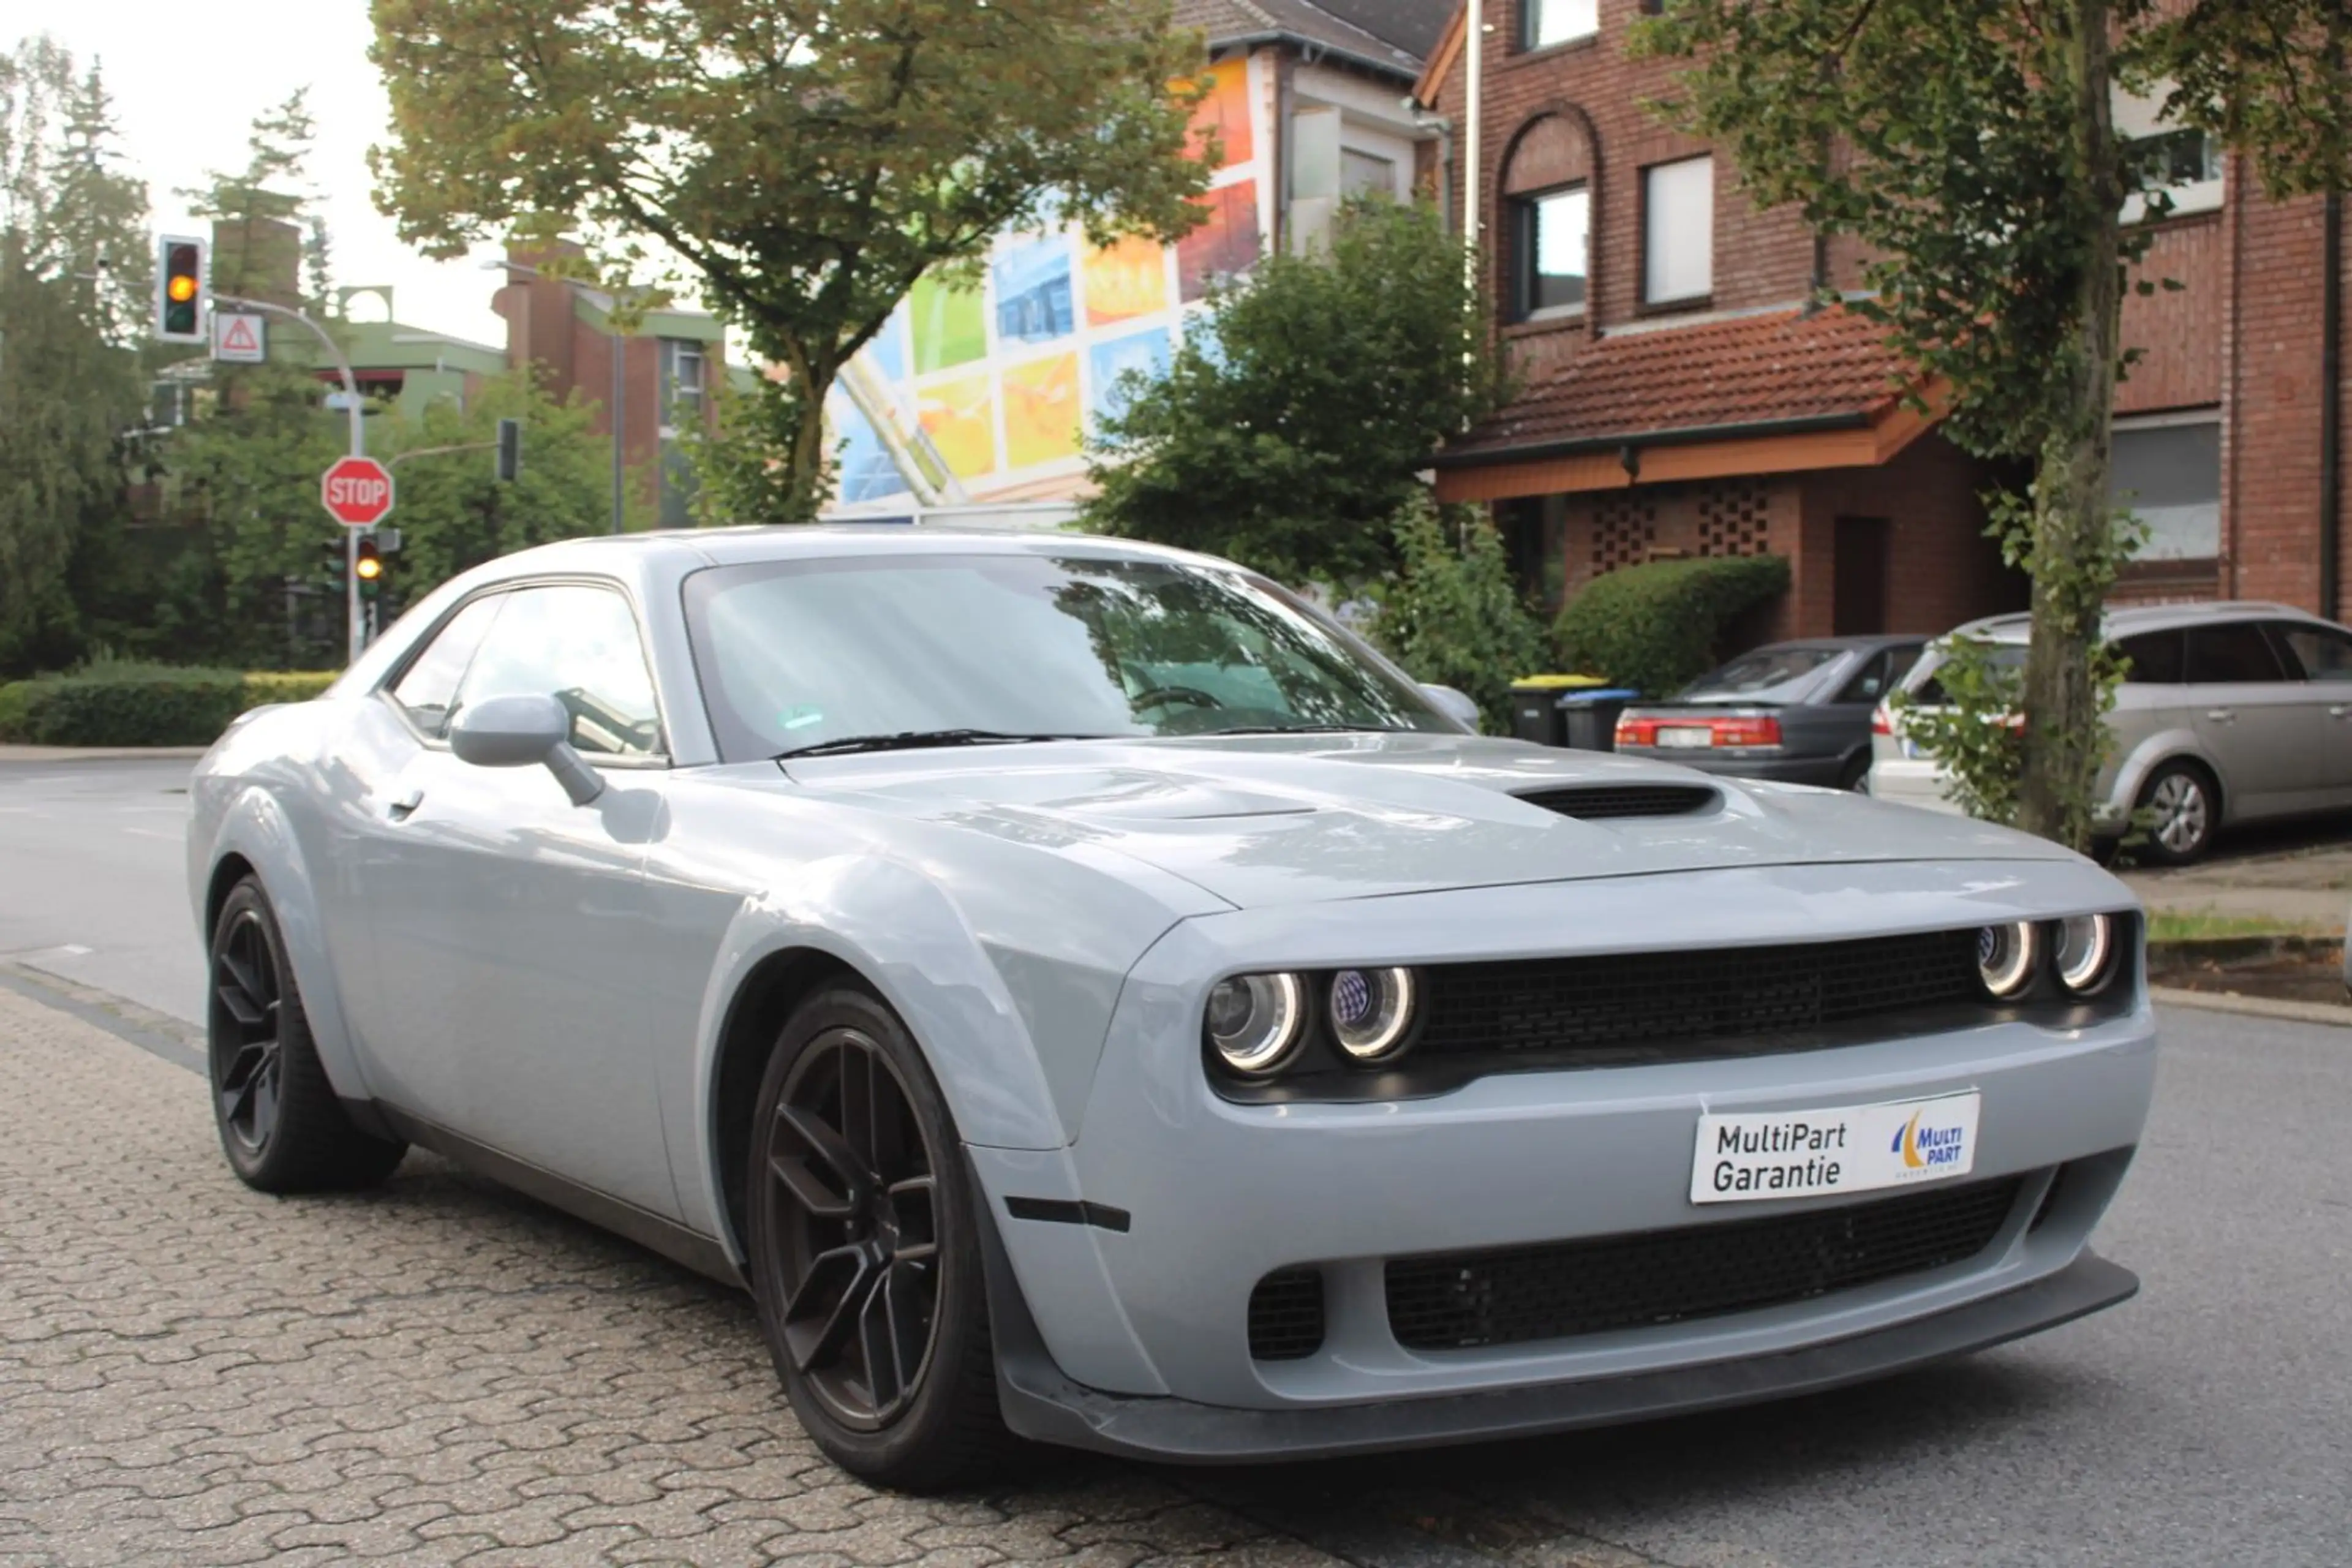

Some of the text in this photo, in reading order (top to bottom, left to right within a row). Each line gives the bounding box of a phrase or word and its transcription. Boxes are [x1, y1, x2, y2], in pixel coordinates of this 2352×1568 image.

[330, 478, 386, 506] STOP
[1717, 1123, 1846, 1154] MultiPart
[1927, 1145, 1962, 1166] PART
[1714, 1155, 1840, 1191] Garantie
